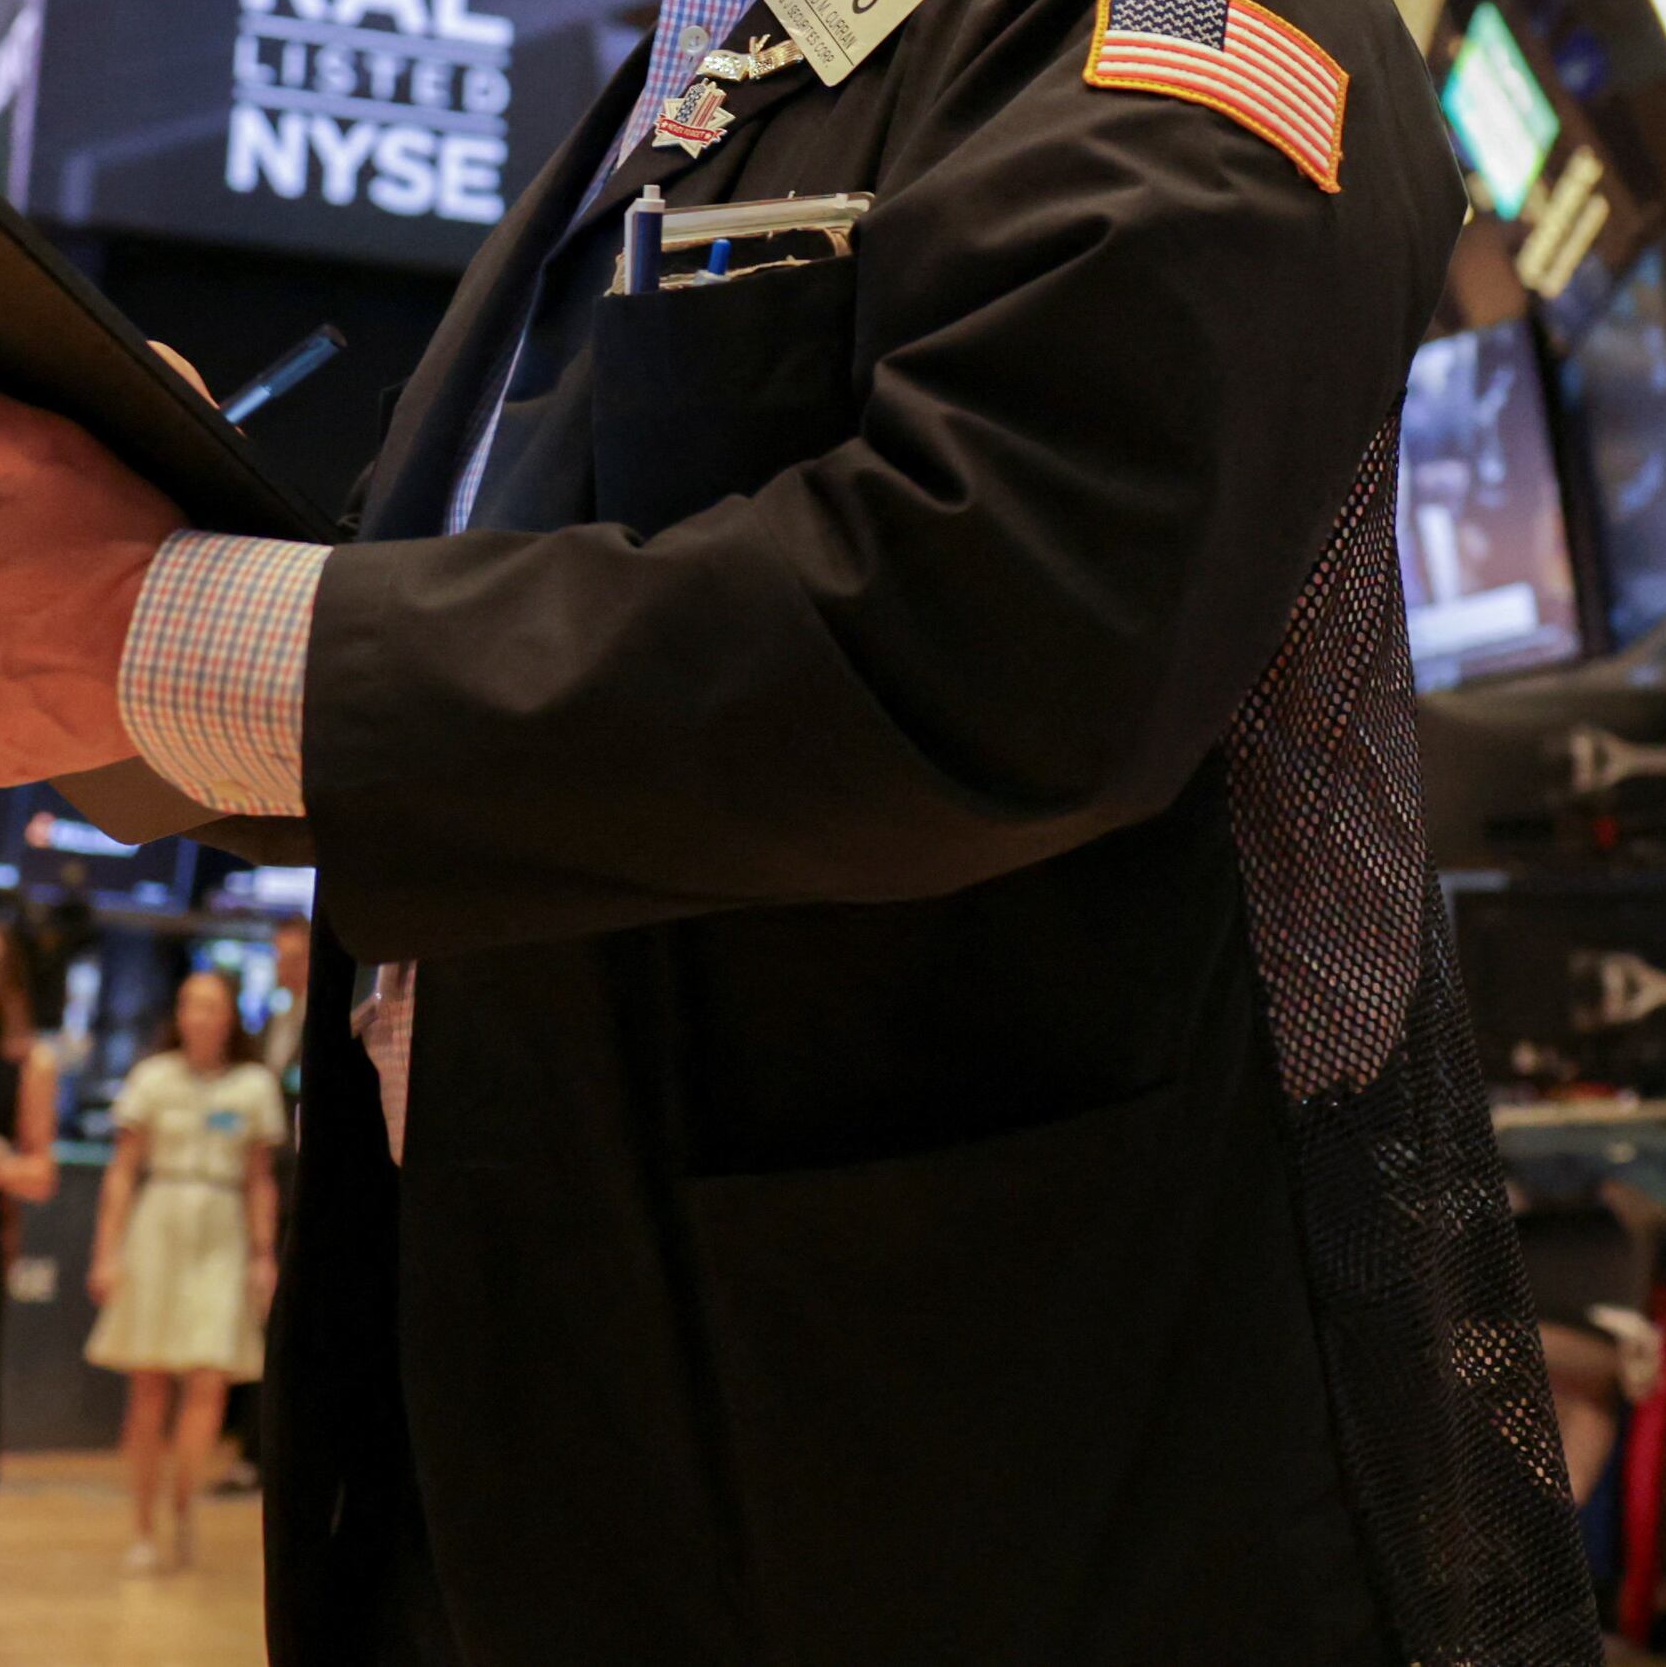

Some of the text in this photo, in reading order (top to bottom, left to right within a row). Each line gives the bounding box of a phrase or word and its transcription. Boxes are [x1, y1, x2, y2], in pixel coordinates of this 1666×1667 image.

[824, 10, 860, 50] CURRAN
[234, 36, 511, 116] LISTED
[225, 103, 508, 223] NYSE
